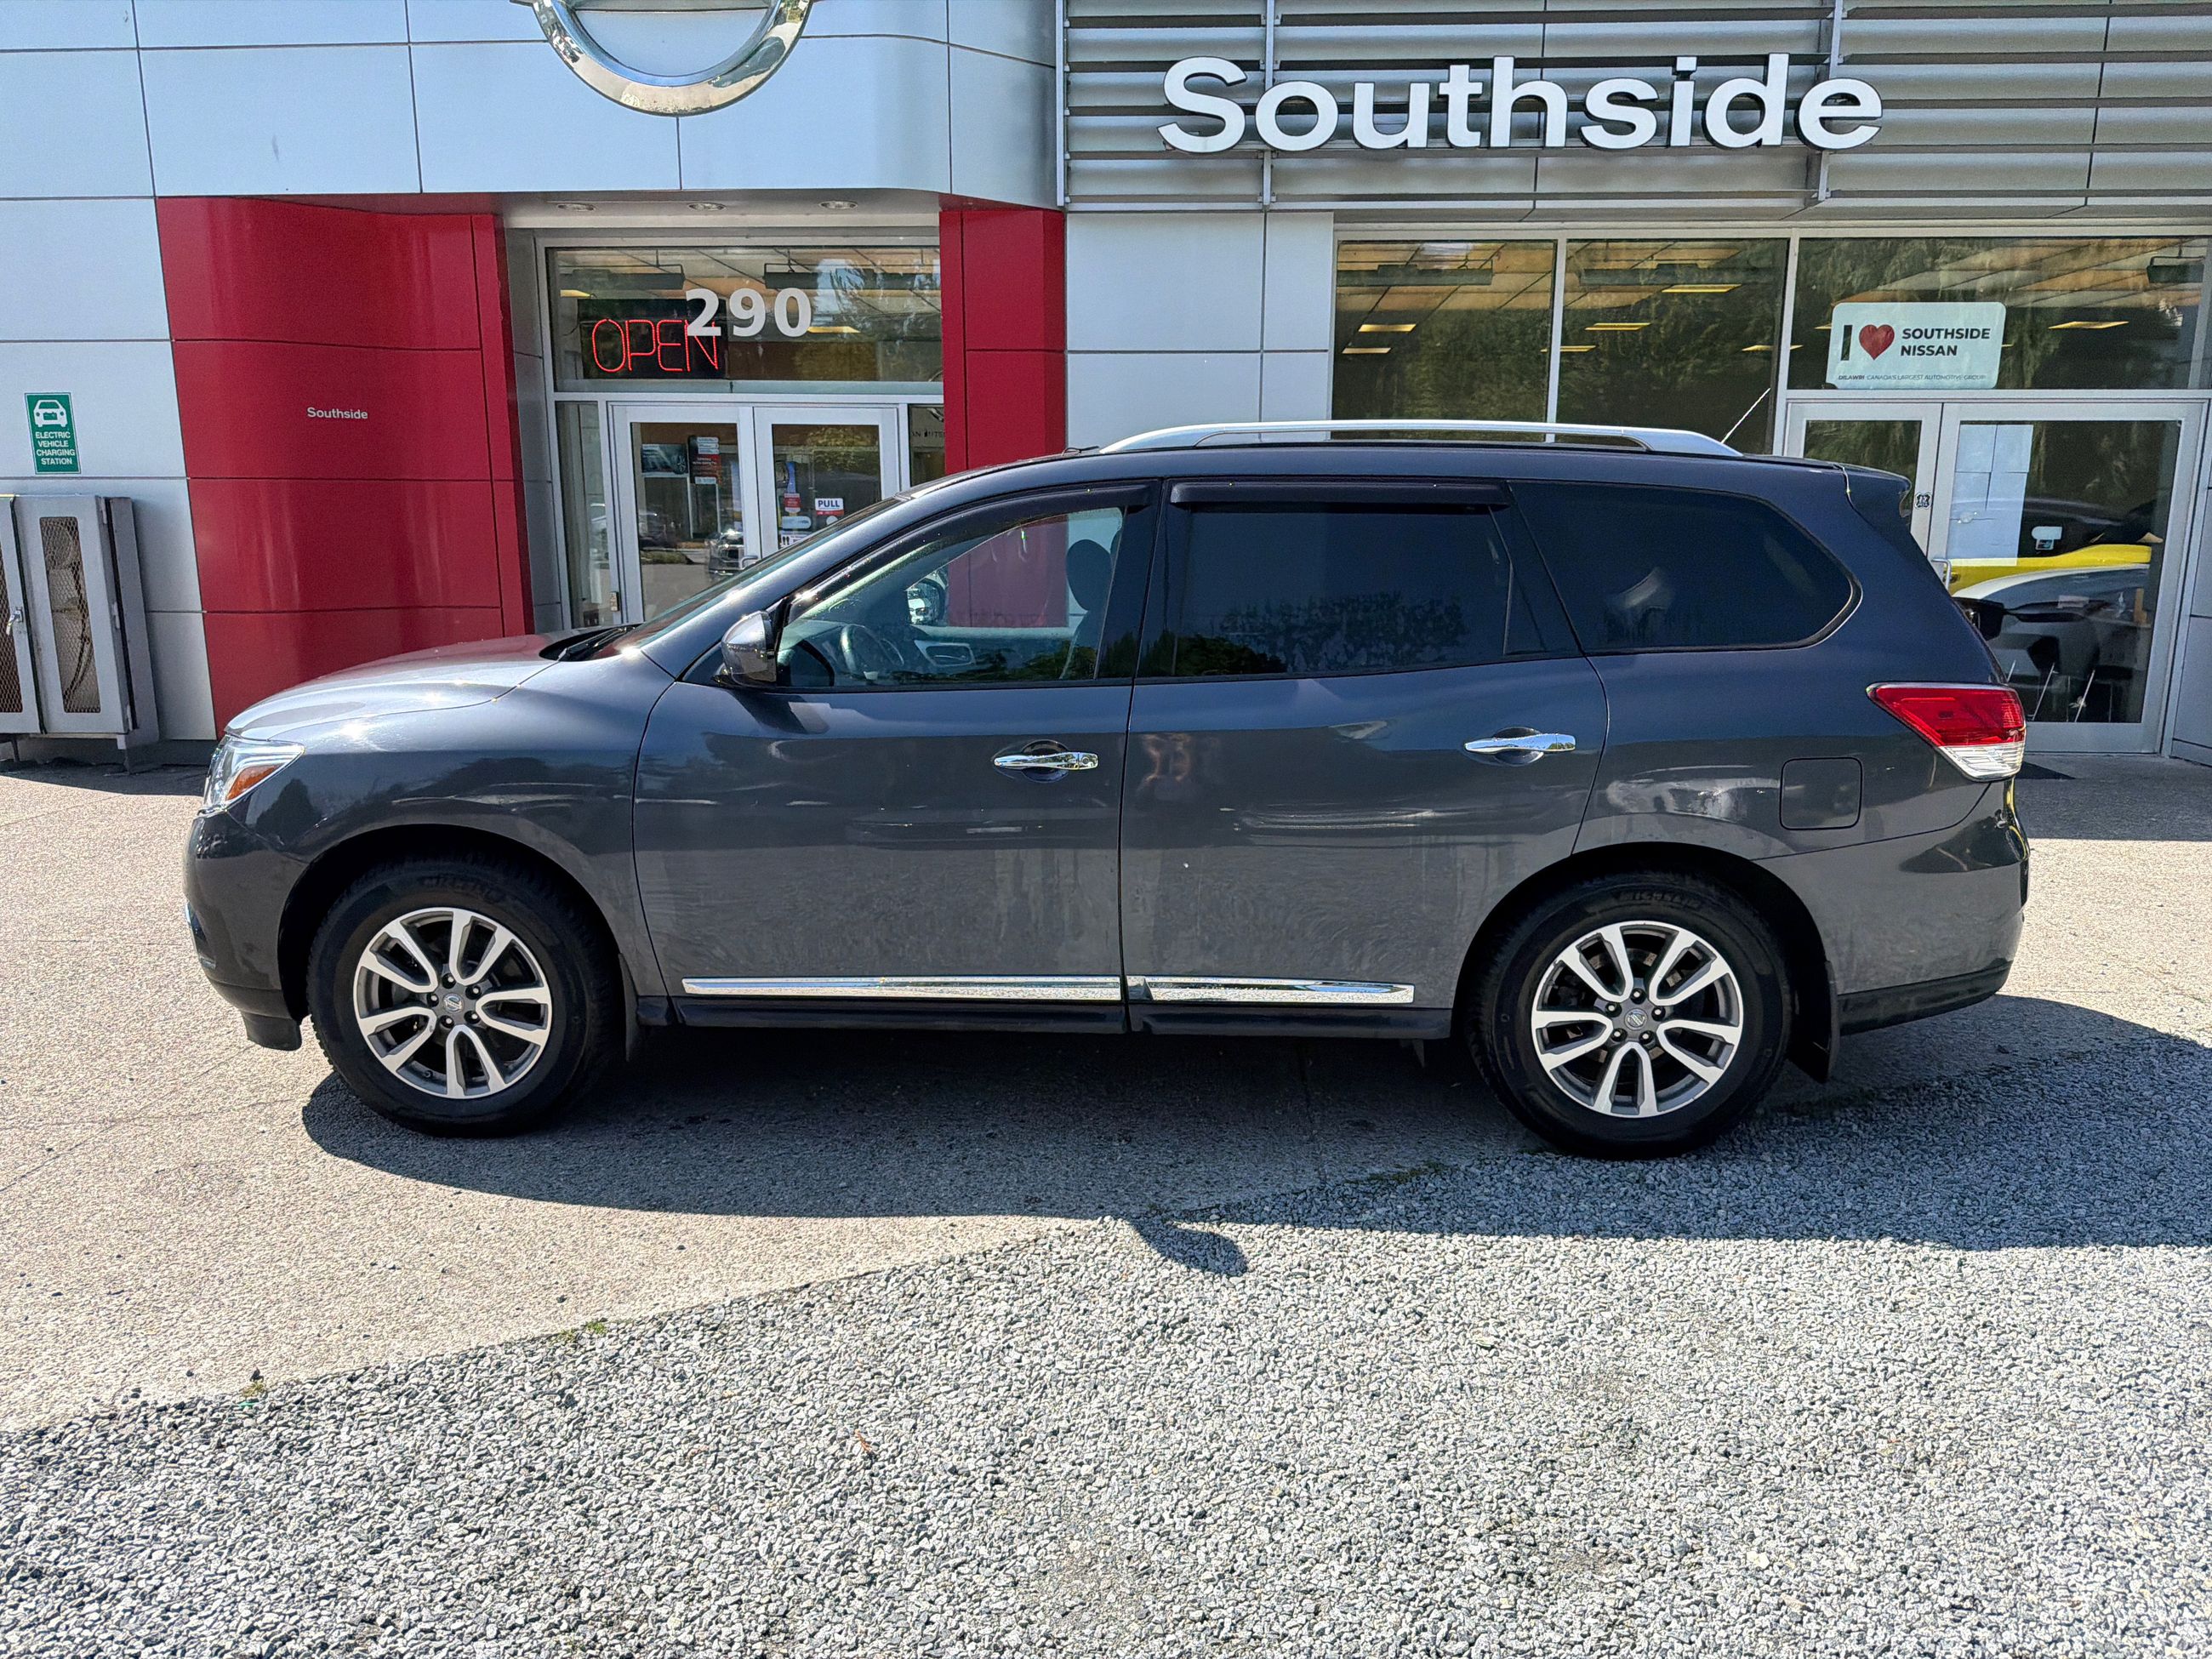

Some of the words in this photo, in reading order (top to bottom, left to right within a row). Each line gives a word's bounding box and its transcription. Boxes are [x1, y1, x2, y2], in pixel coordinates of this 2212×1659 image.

[1156, 53, 1883, 153] Southside
[685, 288, 812, 338] 290
[591, 318, 719, 373] OPEN
[1840, 324, 1853, 362] I
[1901, 328, 1991, 339] SOUTHSIDE
[1900, 345, 1958, 356] NISSAN
[306, 407, 368, 419] Southside
[818, 499, 841, 508] PULL
